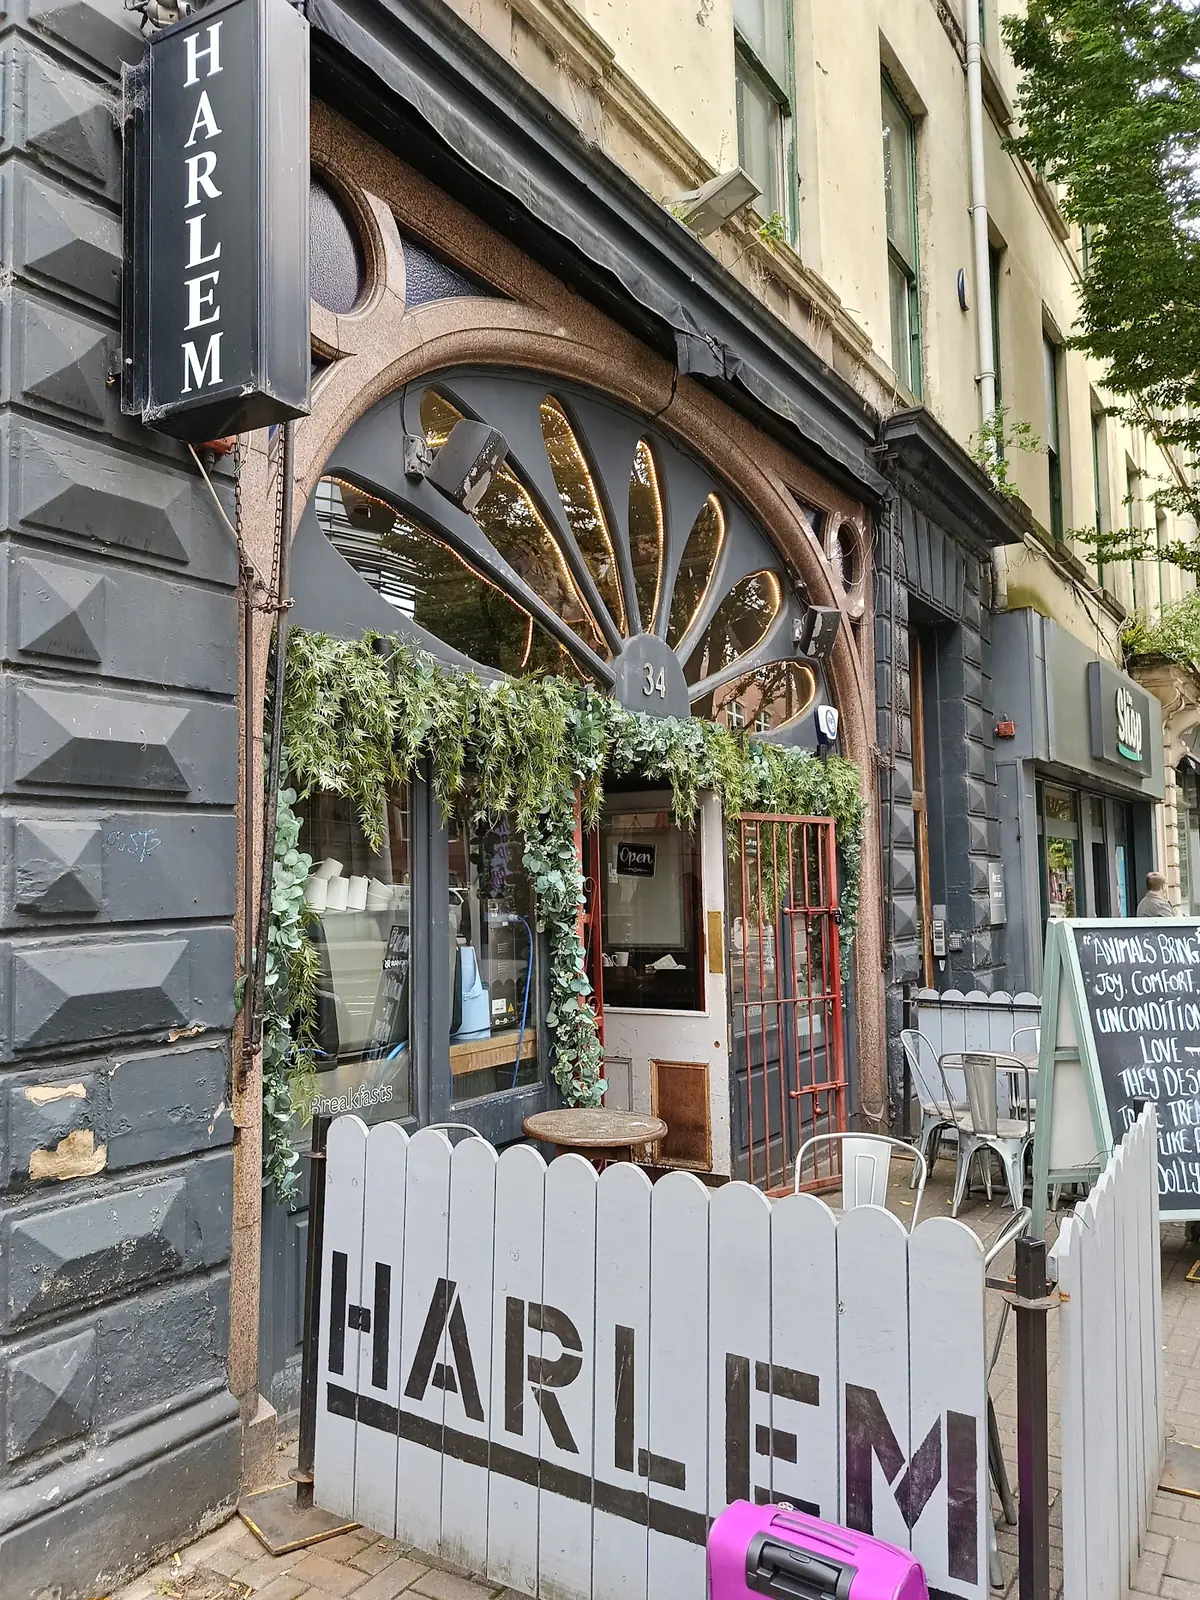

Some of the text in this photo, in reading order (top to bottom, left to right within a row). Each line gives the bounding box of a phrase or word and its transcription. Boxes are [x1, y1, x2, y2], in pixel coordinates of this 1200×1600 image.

[181, 20, 224, 394] HARLEM
[642, 662, 666, 699] 34
[620, 847, 653, 867] Open
[1139, 1035, 1183, 1063] LOVE
[311, 1083, 393, 1115] Breakfasts
[1117, 1065, 1200, 1100] THEY DES
[1158, 1128, 1192, 1155] LIKE
[327, 1251, 978, 1585] HARLEM
